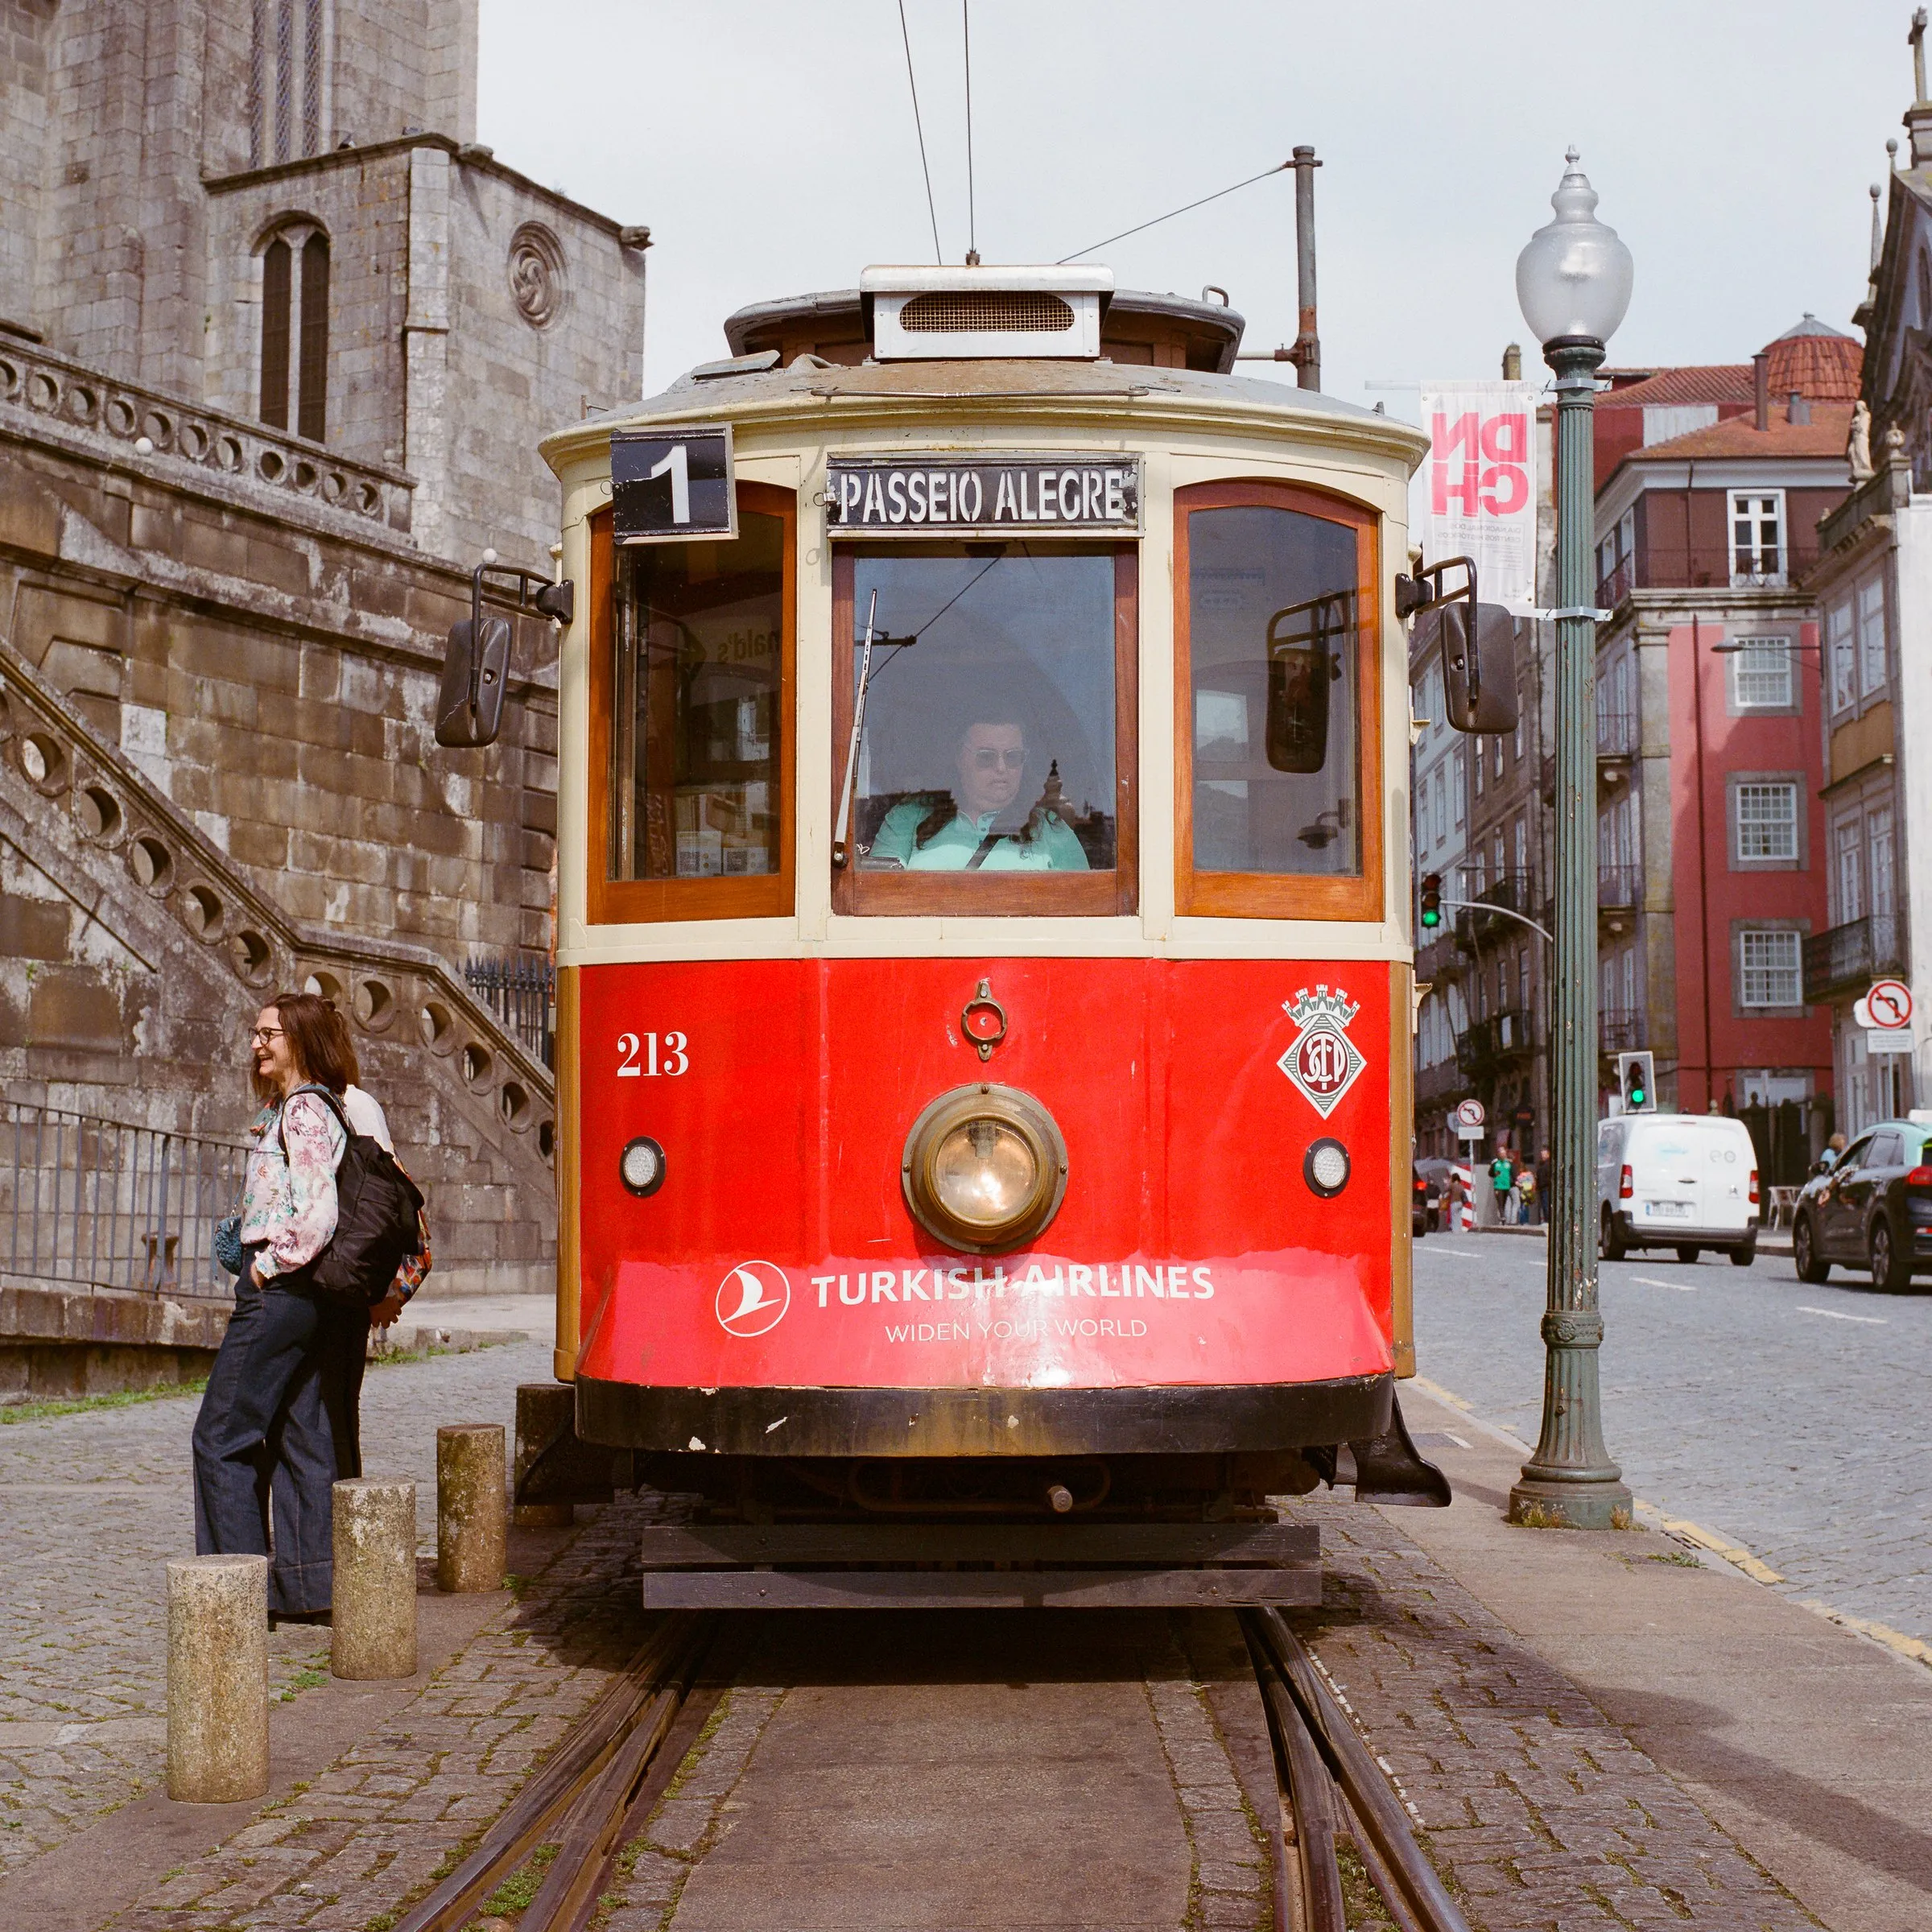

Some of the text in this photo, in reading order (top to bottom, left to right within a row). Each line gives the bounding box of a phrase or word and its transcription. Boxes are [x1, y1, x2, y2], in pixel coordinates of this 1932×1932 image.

[650, 444, 691, 524] 1
[840, 469, 1123, 523] PASSEIO ALEGRE
[617, 1031, 689, 1076] 213
[811, 1264, 1215, 1308] TURKISH AIRLINES
[885, 1319, 1148, 1344] WIDEN YOUR WORLD
